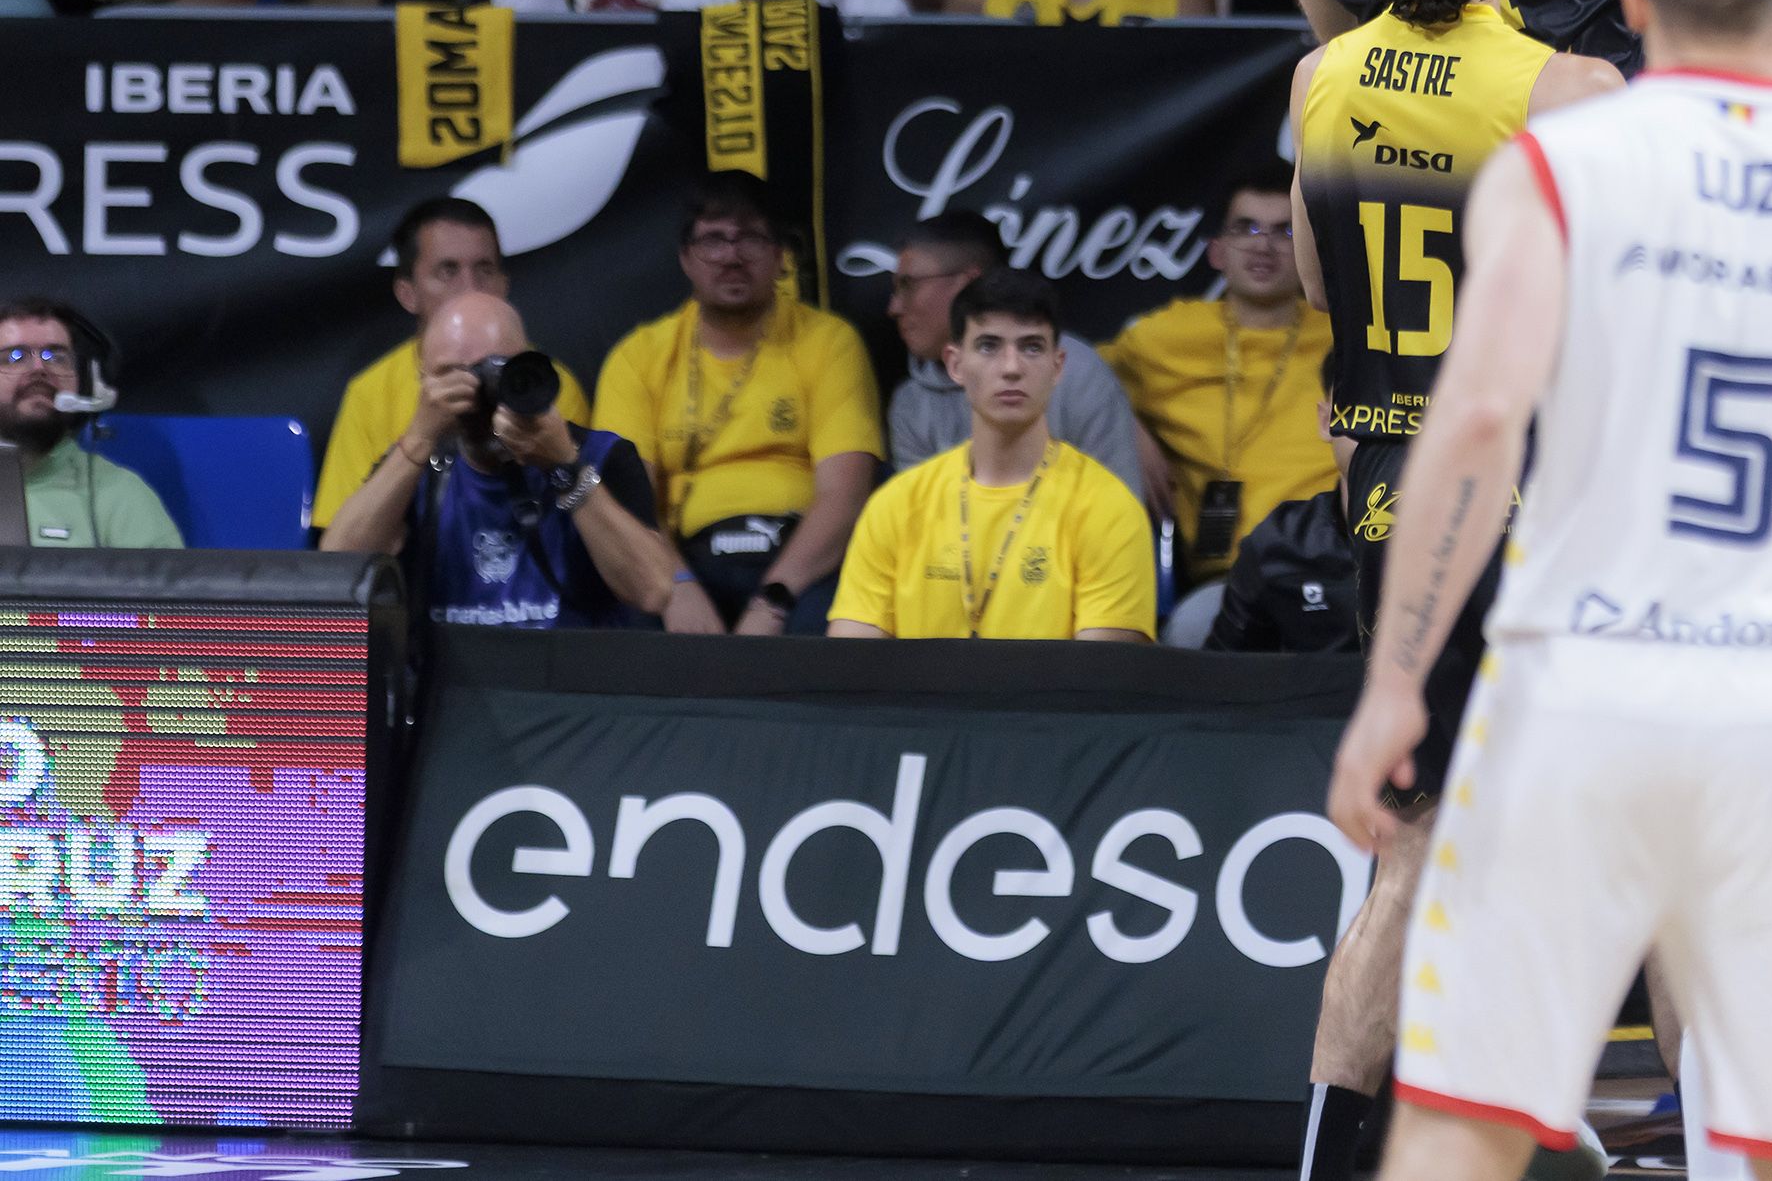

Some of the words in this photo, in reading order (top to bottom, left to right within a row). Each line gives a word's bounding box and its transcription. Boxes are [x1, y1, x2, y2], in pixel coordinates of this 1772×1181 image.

[85, 61, 356, 115] IBERIA
[1359, 47, 1461, 97] SASTRE
[1358, 201, 1454, 357] 15
[1391, 392, 1436, 407] IBERI
[443, 752, 1372, 969] endesa
